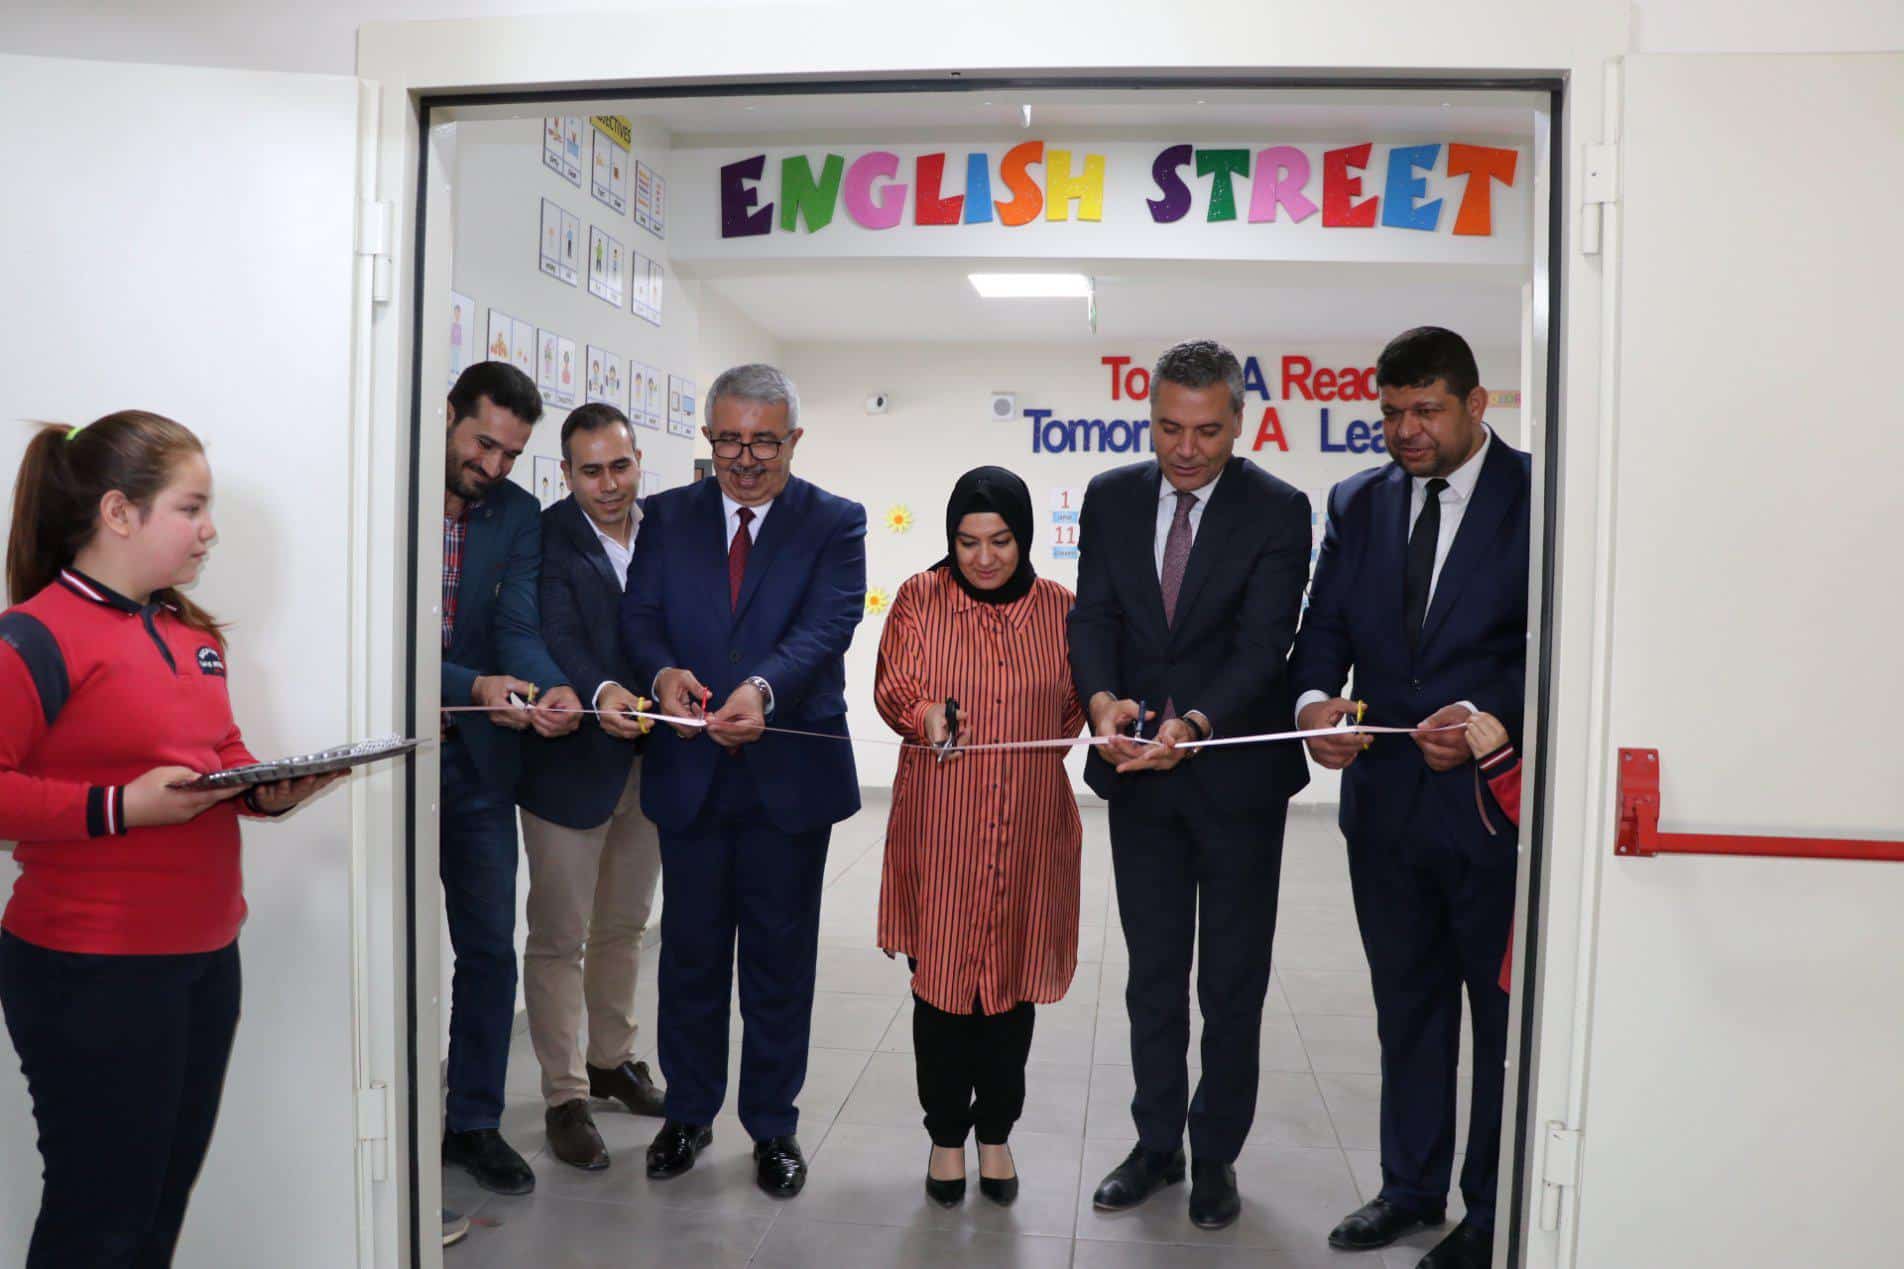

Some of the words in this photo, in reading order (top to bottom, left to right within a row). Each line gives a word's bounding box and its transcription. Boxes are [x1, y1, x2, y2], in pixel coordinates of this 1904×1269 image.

[721, 140, 1106, 239] ENGLISH
[1146, 142, 1518, 236] STREET
[1243, 356, 1271, 401] A
[1023, 408, 1156, 454] Tomor
[1252, 406, 1289, 452] A
[1060, 490, 1070, 509] 1
[1055, 525, 1076, 545] 11
